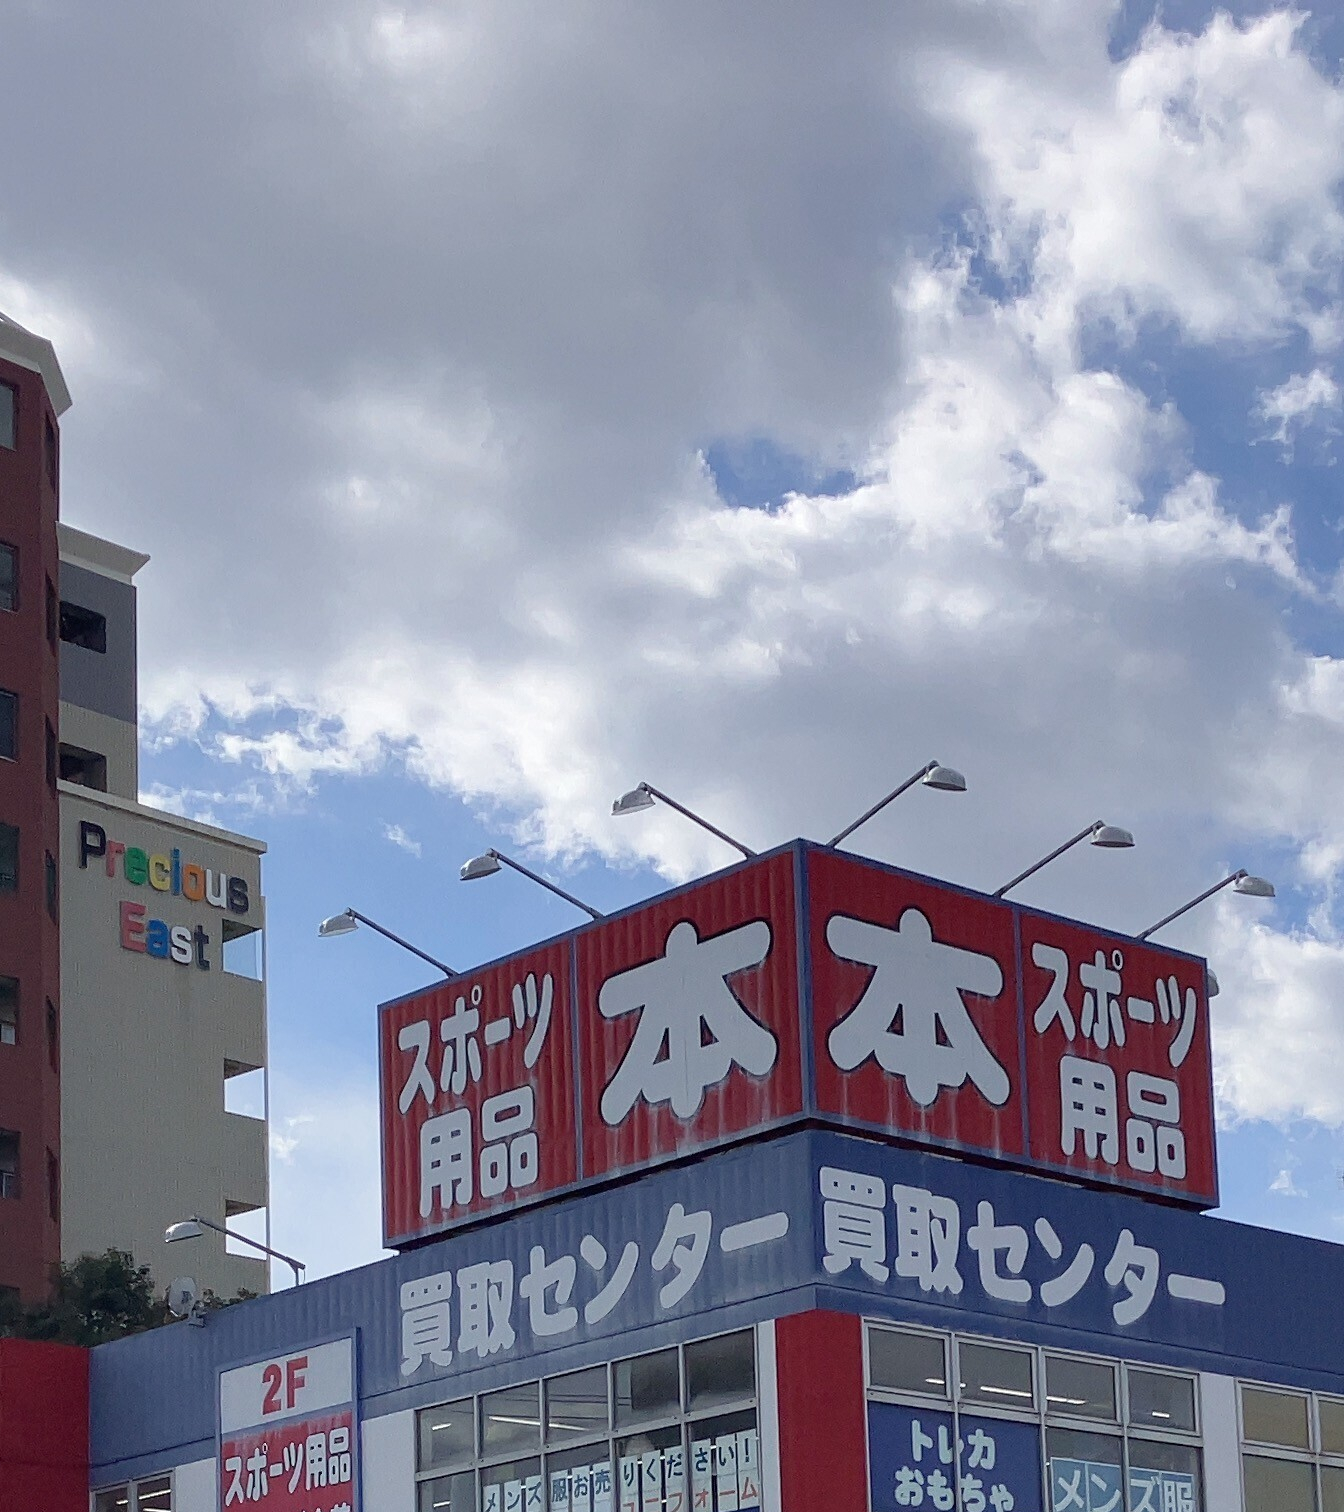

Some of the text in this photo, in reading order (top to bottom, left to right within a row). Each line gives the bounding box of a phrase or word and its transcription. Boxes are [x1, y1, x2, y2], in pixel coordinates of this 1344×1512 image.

[79, 820, 249, 914] Precious
[120, 900, 210, 971] East
[398, 971, 554, 1115] スポーツ
[598, 920, 778, 1128] 本
[825, 907, 1012, 1108] 本
[1031, 942, 1196, 1068] スポーツ
[419, 1084, 538, 1218] 用品
[1059, 1055, 1188, 1180] 用品
[399, 1202, 789, 1377] 買取センター
[819, 1165, 1227, 1327] 買取センター
[262, 1356, 308, 1416] 2F
[911, 1419, 995, 1471] トレカ
[225, 1426, 352, 1507] スポーツ用品
